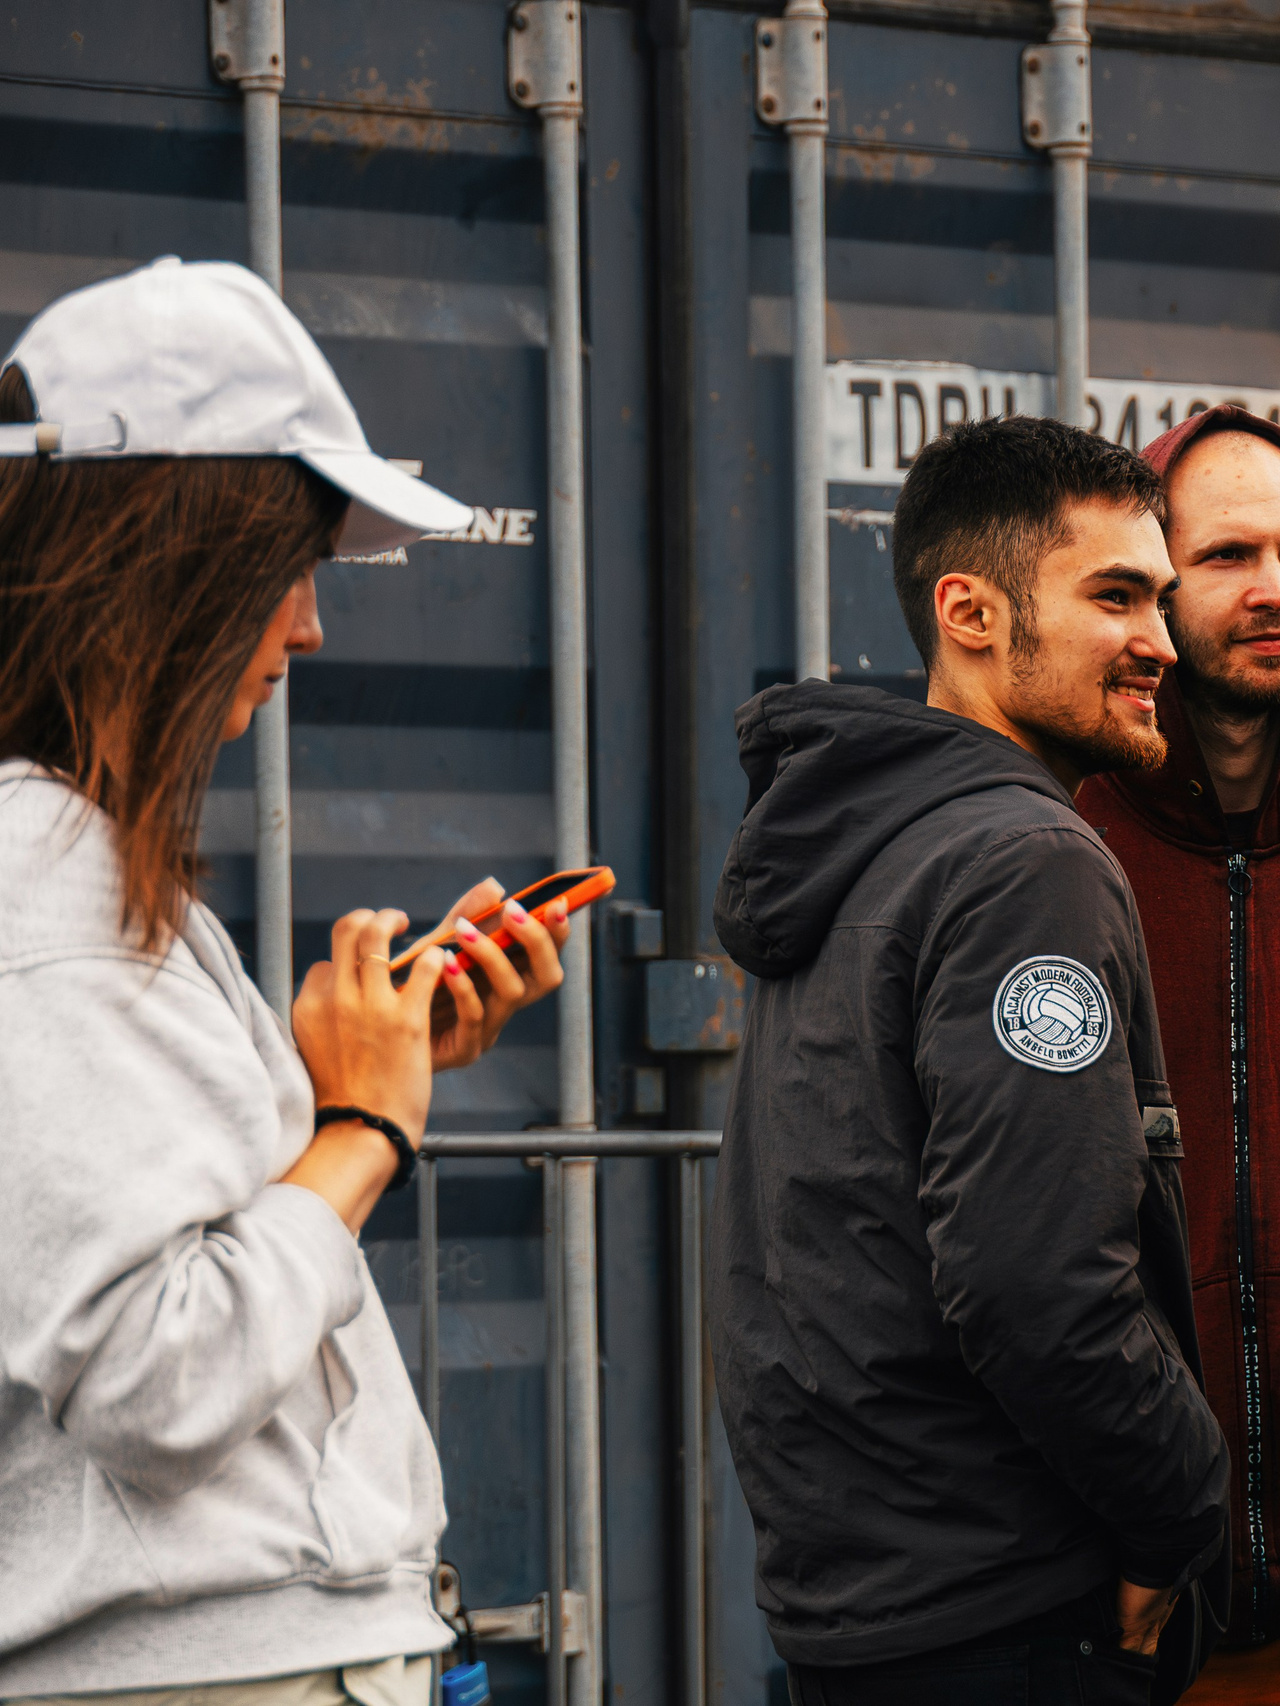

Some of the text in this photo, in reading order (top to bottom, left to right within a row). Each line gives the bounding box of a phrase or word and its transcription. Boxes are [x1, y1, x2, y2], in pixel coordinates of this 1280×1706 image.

[1006, 968, 1099, 1019] AGAINST MODERN FOOTBALL
[1008, 1017, 1020, 1031] 18
[1086, 1020, 1100, 1036] 63
[1018, 1034, 1091, 1060] ANGELO BONETTI
